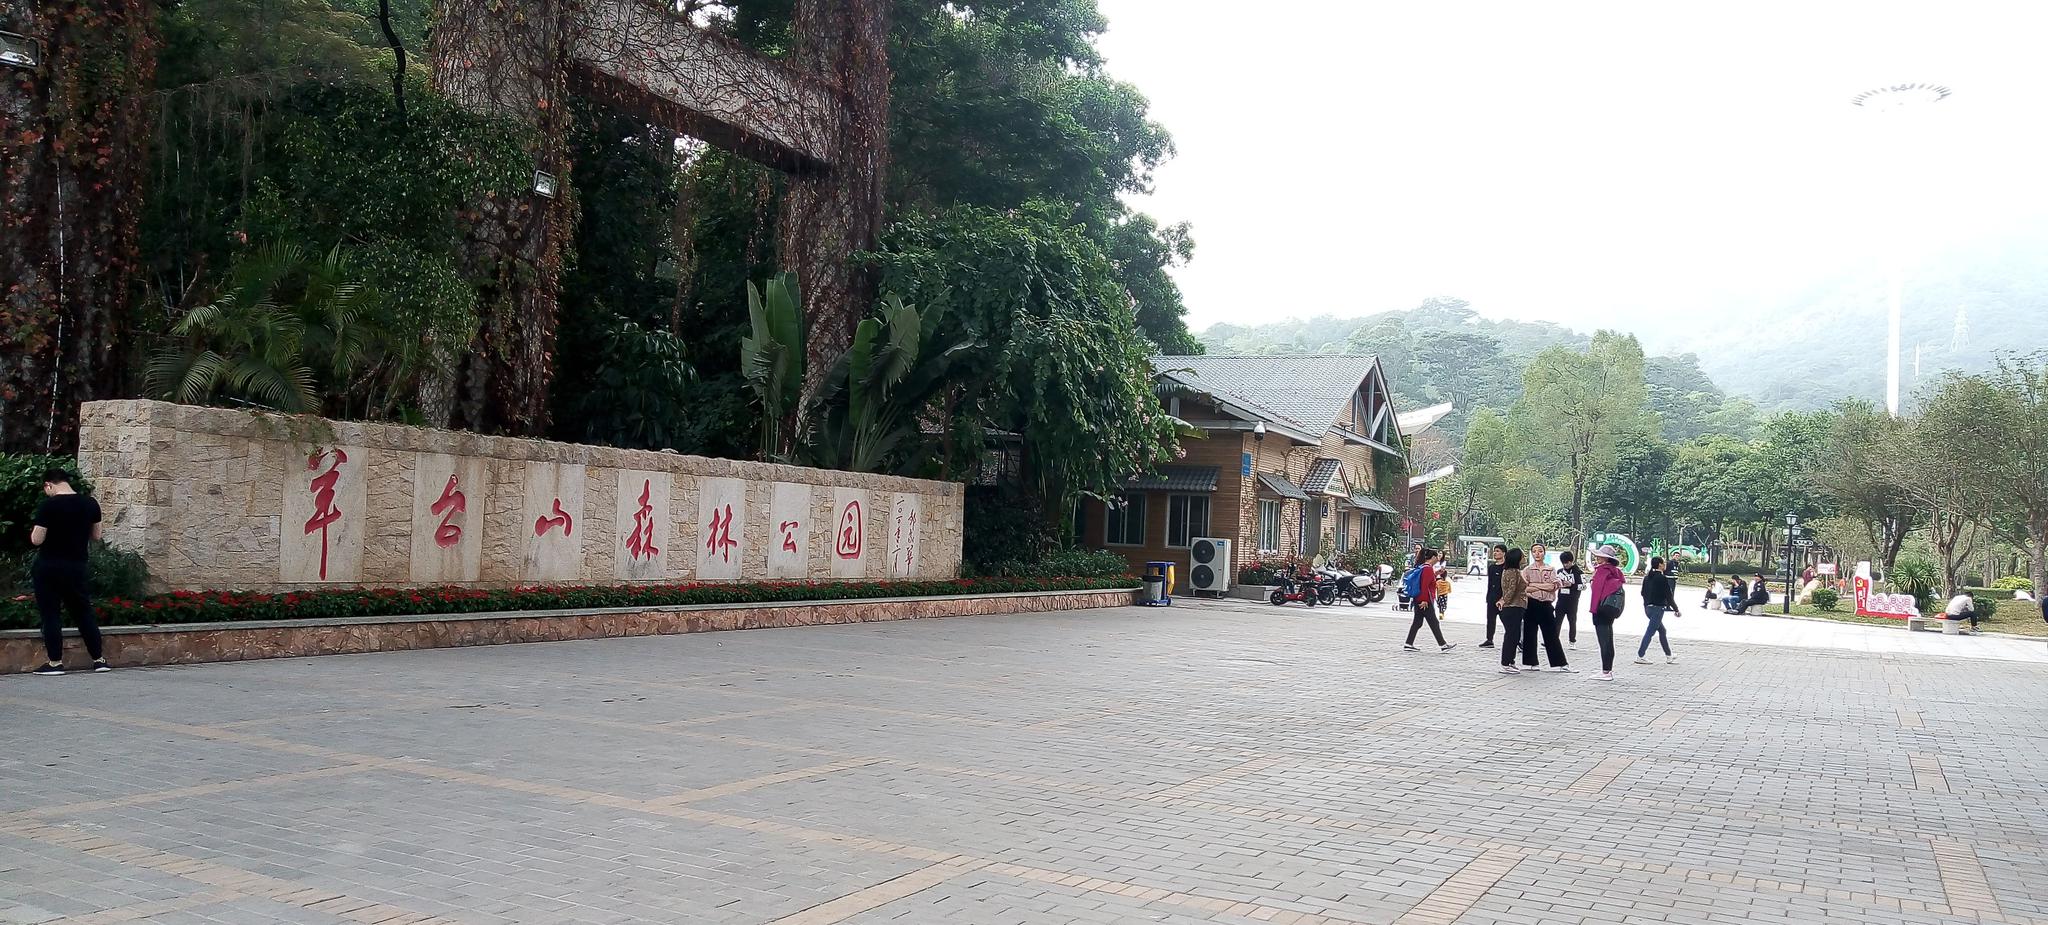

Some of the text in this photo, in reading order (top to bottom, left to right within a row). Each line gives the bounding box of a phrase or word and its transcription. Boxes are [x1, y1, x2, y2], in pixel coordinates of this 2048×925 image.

[304, 448, 862, 580] 羊台山森林公园
